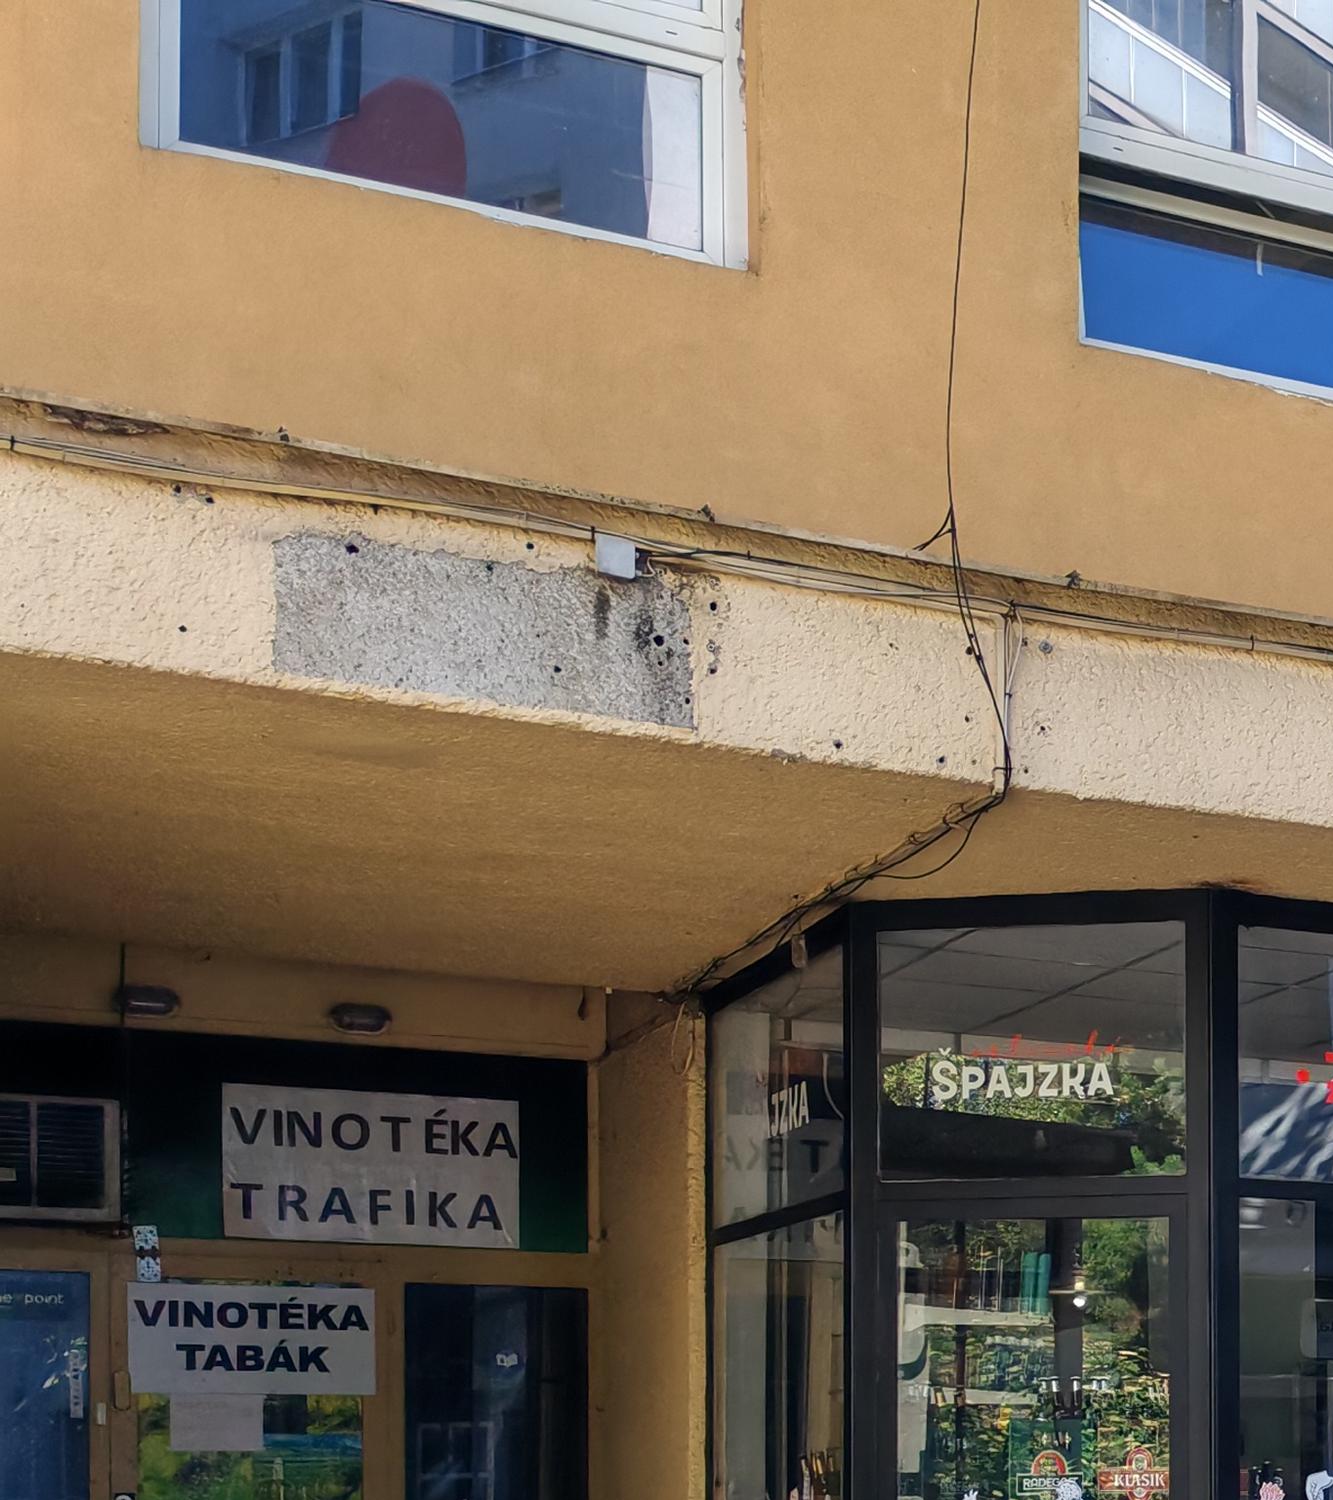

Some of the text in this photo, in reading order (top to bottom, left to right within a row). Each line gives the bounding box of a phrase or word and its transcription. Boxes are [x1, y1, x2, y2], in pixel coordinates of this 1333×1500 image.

[932, 1048, 1114, 1100] ŠPAJZKA
[229, 1106, 519, 1160] VINOTÉKA
[229, 1180, 504, 1232] TRAFIKA
[133, 1297, 370, 1333] VINOTÉKA
[176, 1339, 330, 1375] TABÁK
[1113, 1474, 1165, 1487] KLASIK
